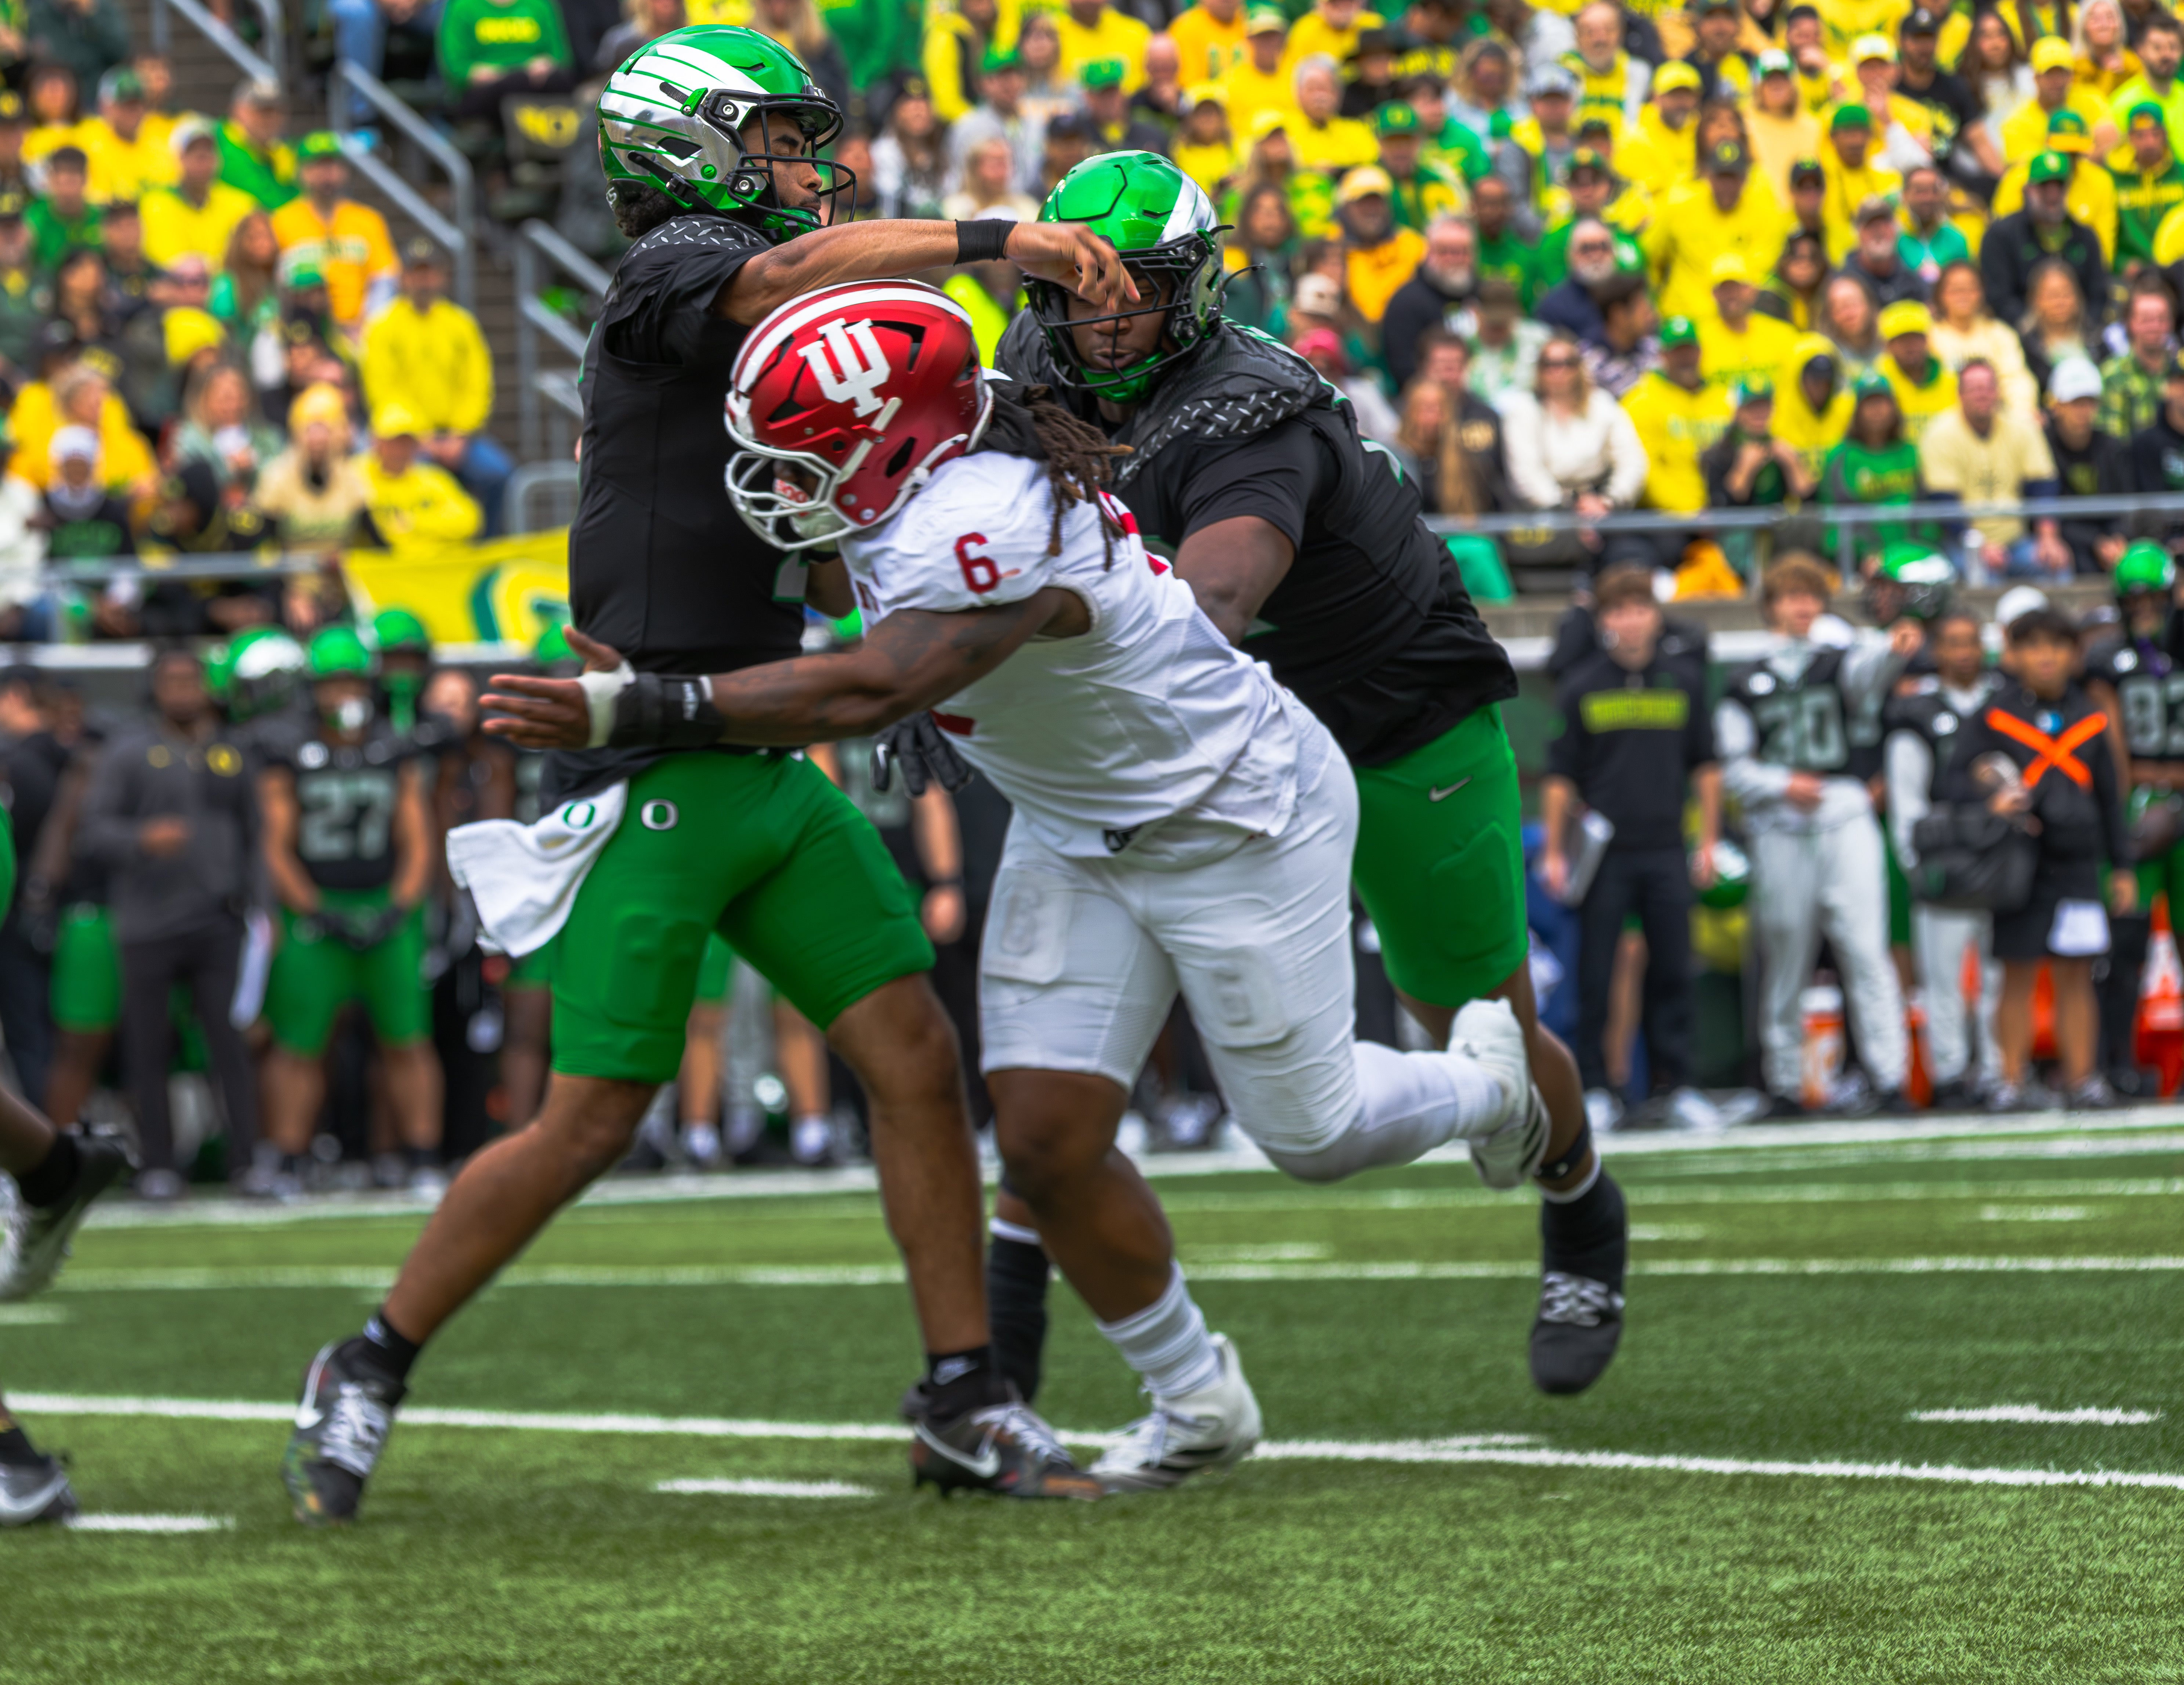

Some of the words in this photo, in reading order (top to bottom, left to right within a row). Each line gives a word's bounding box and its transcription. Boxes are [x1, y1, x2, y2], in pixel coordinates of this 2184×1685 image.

[954, 532, 1000, 593] 6
[298, 770, 397, 861] 27
[641, 798, 679, 830] O
